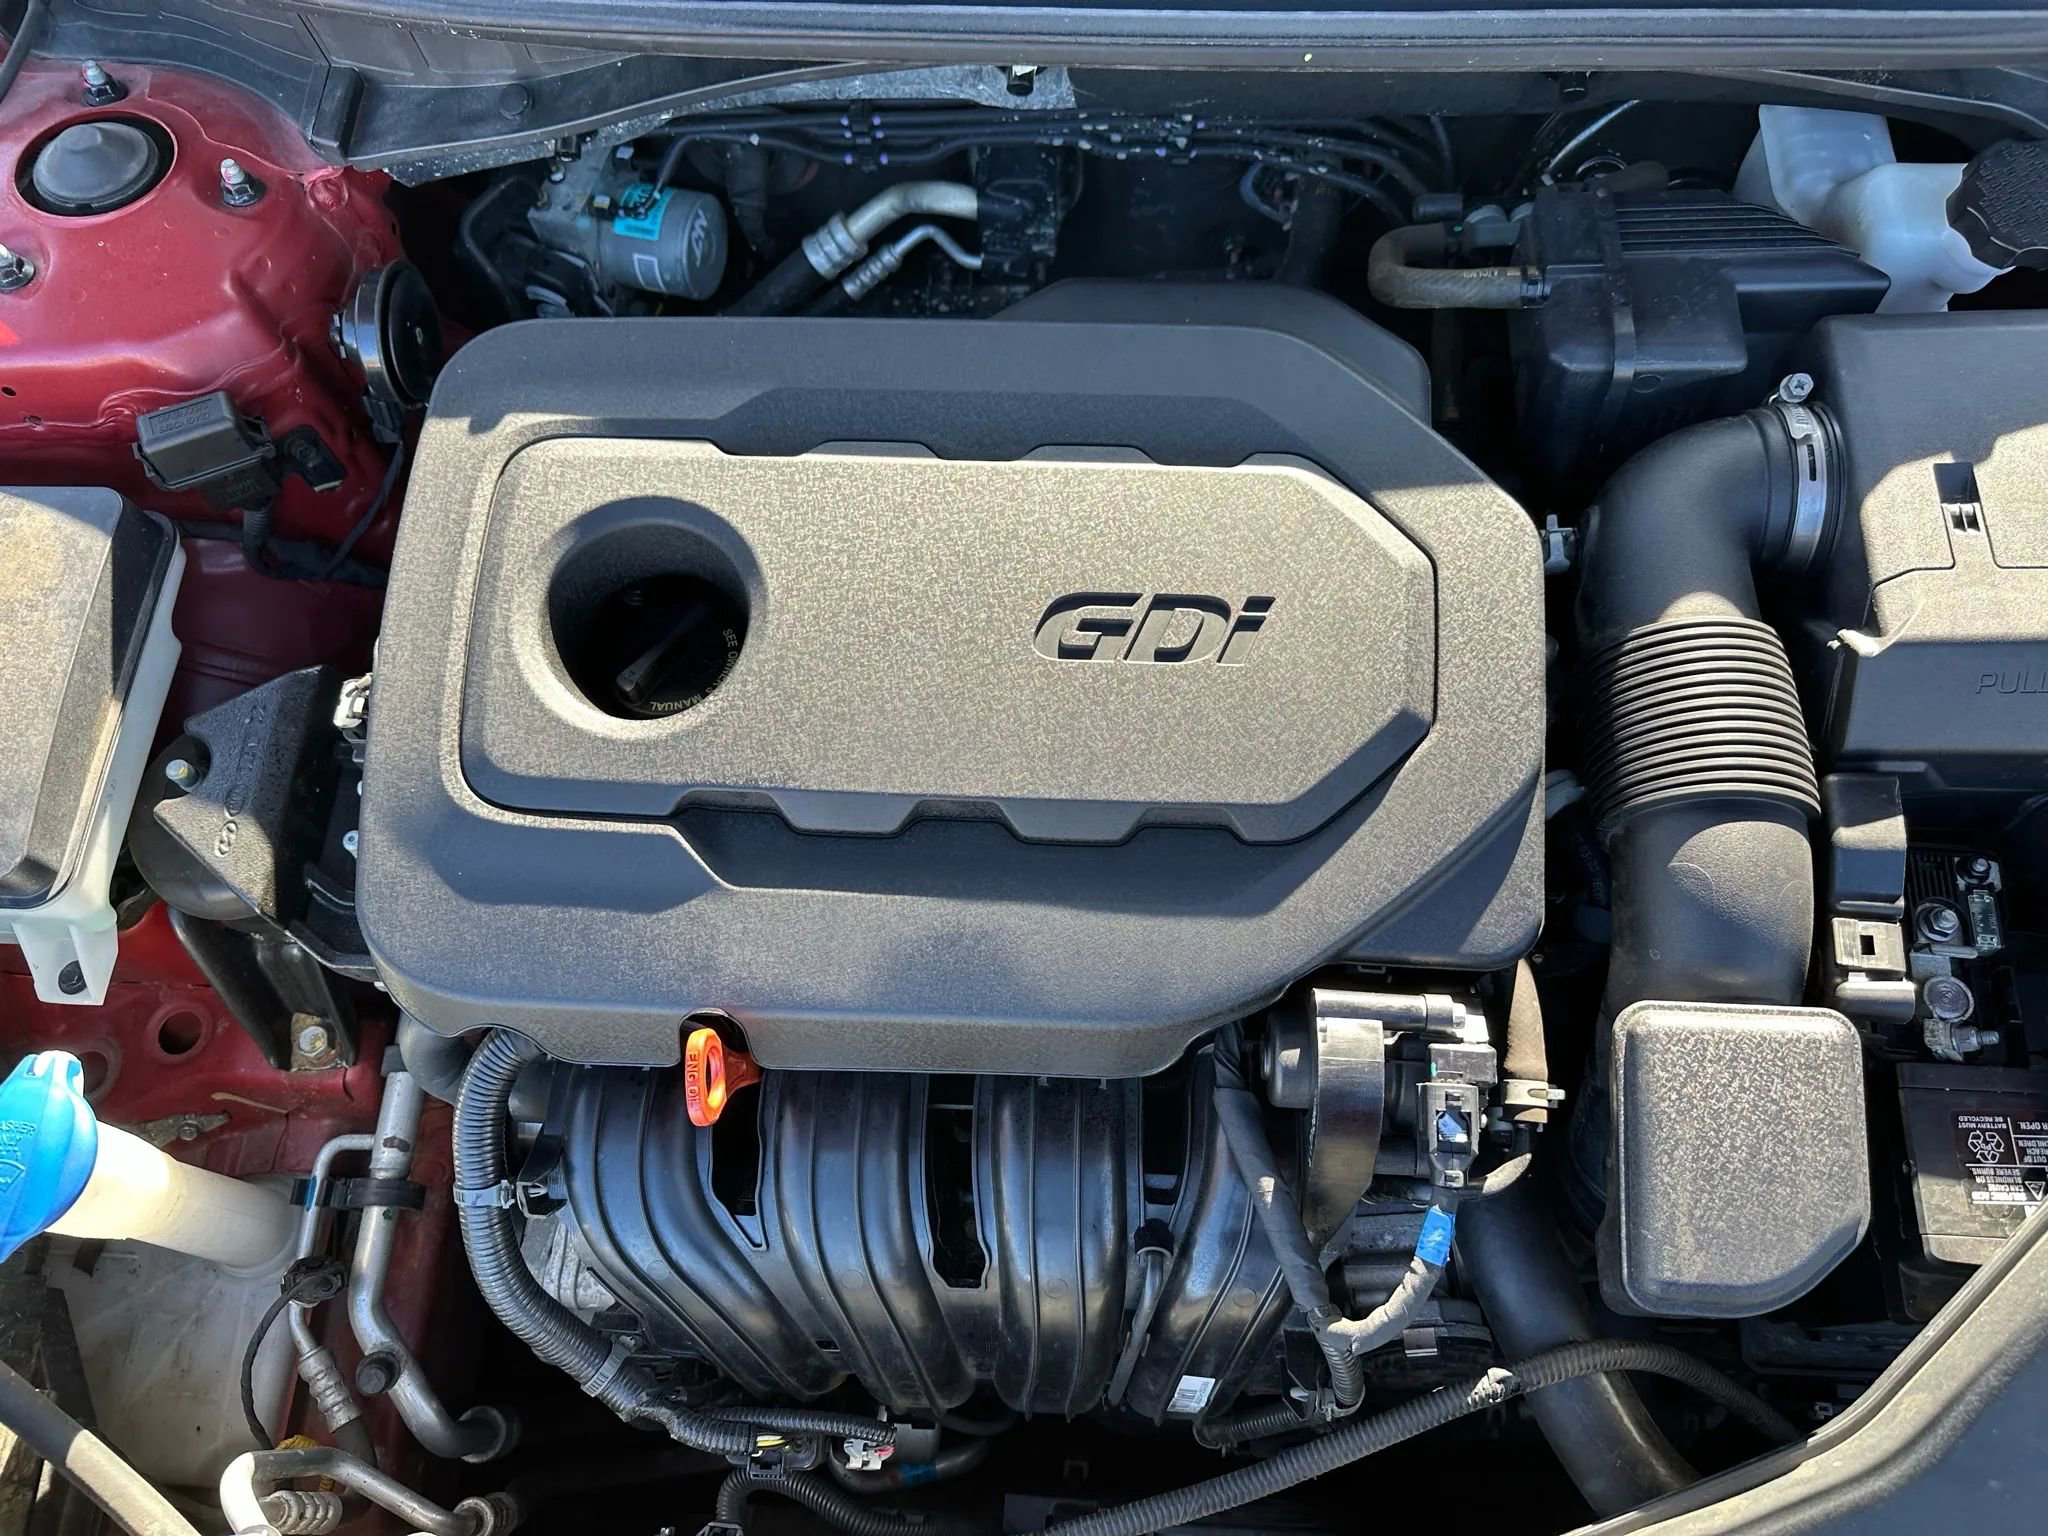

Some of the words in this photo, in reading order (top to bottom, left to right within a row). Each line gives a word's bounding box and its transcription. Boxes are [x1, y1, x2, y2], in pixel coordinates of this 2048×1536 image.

[723, 628, 738, 648] SEE
[1033, 592, 1277, 666] GDi
[1976, 672, 2048, 694] PULL
[650, 694, 702, 711] MANUAL
[686, 1051, 699, 1082] ENG
[687, 1085, 701, 1108] OIL
[2023, 1155, 2033, 1163] OF
[2033, 1155, 2047, 1163] OUT
[1995, 1168, 2021, 1176] SEVERE
